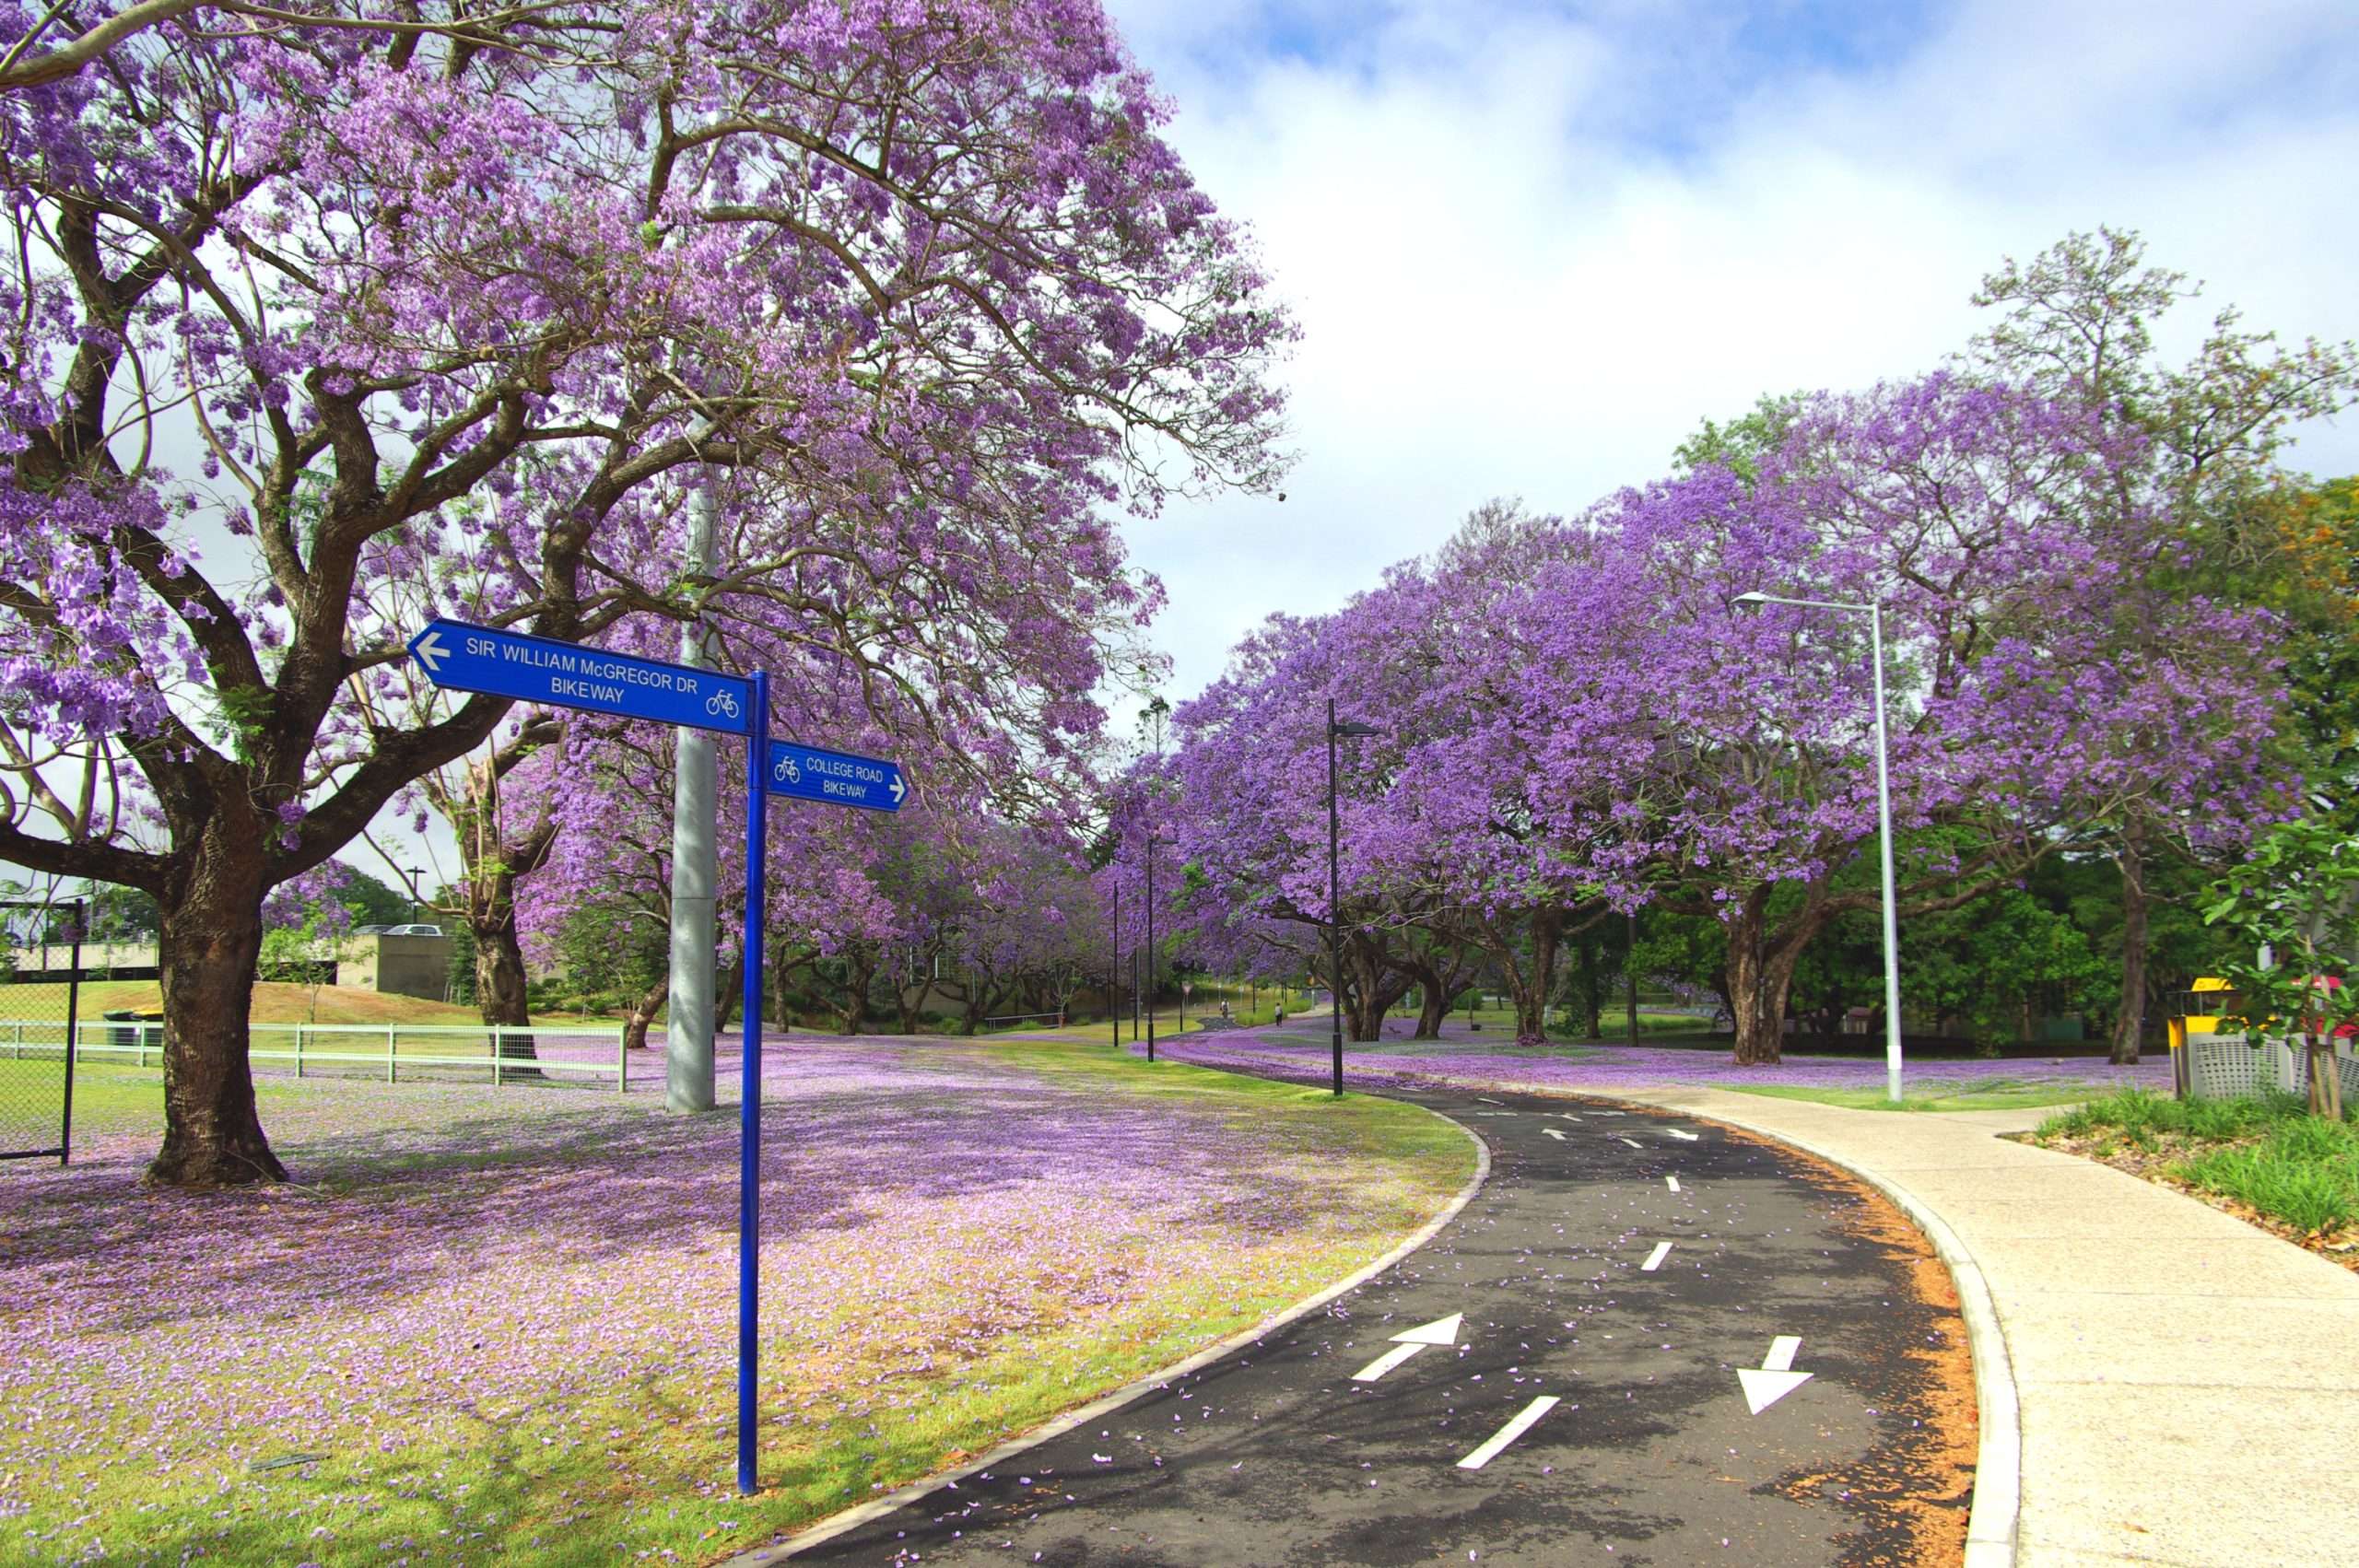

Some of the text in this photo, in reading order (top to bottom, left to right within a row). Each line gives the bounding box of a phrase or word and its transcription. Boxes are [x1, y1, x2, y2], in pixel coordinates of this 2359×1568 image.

[465, 638, 698, 695] SIR WILLIAM McGREGOR DR
[551, 678, 626, 705] BIKEWAY
[806, 756, 884, 783] COLLEGE ROAD
[823, 779, 868, 800] BIKEWAY
